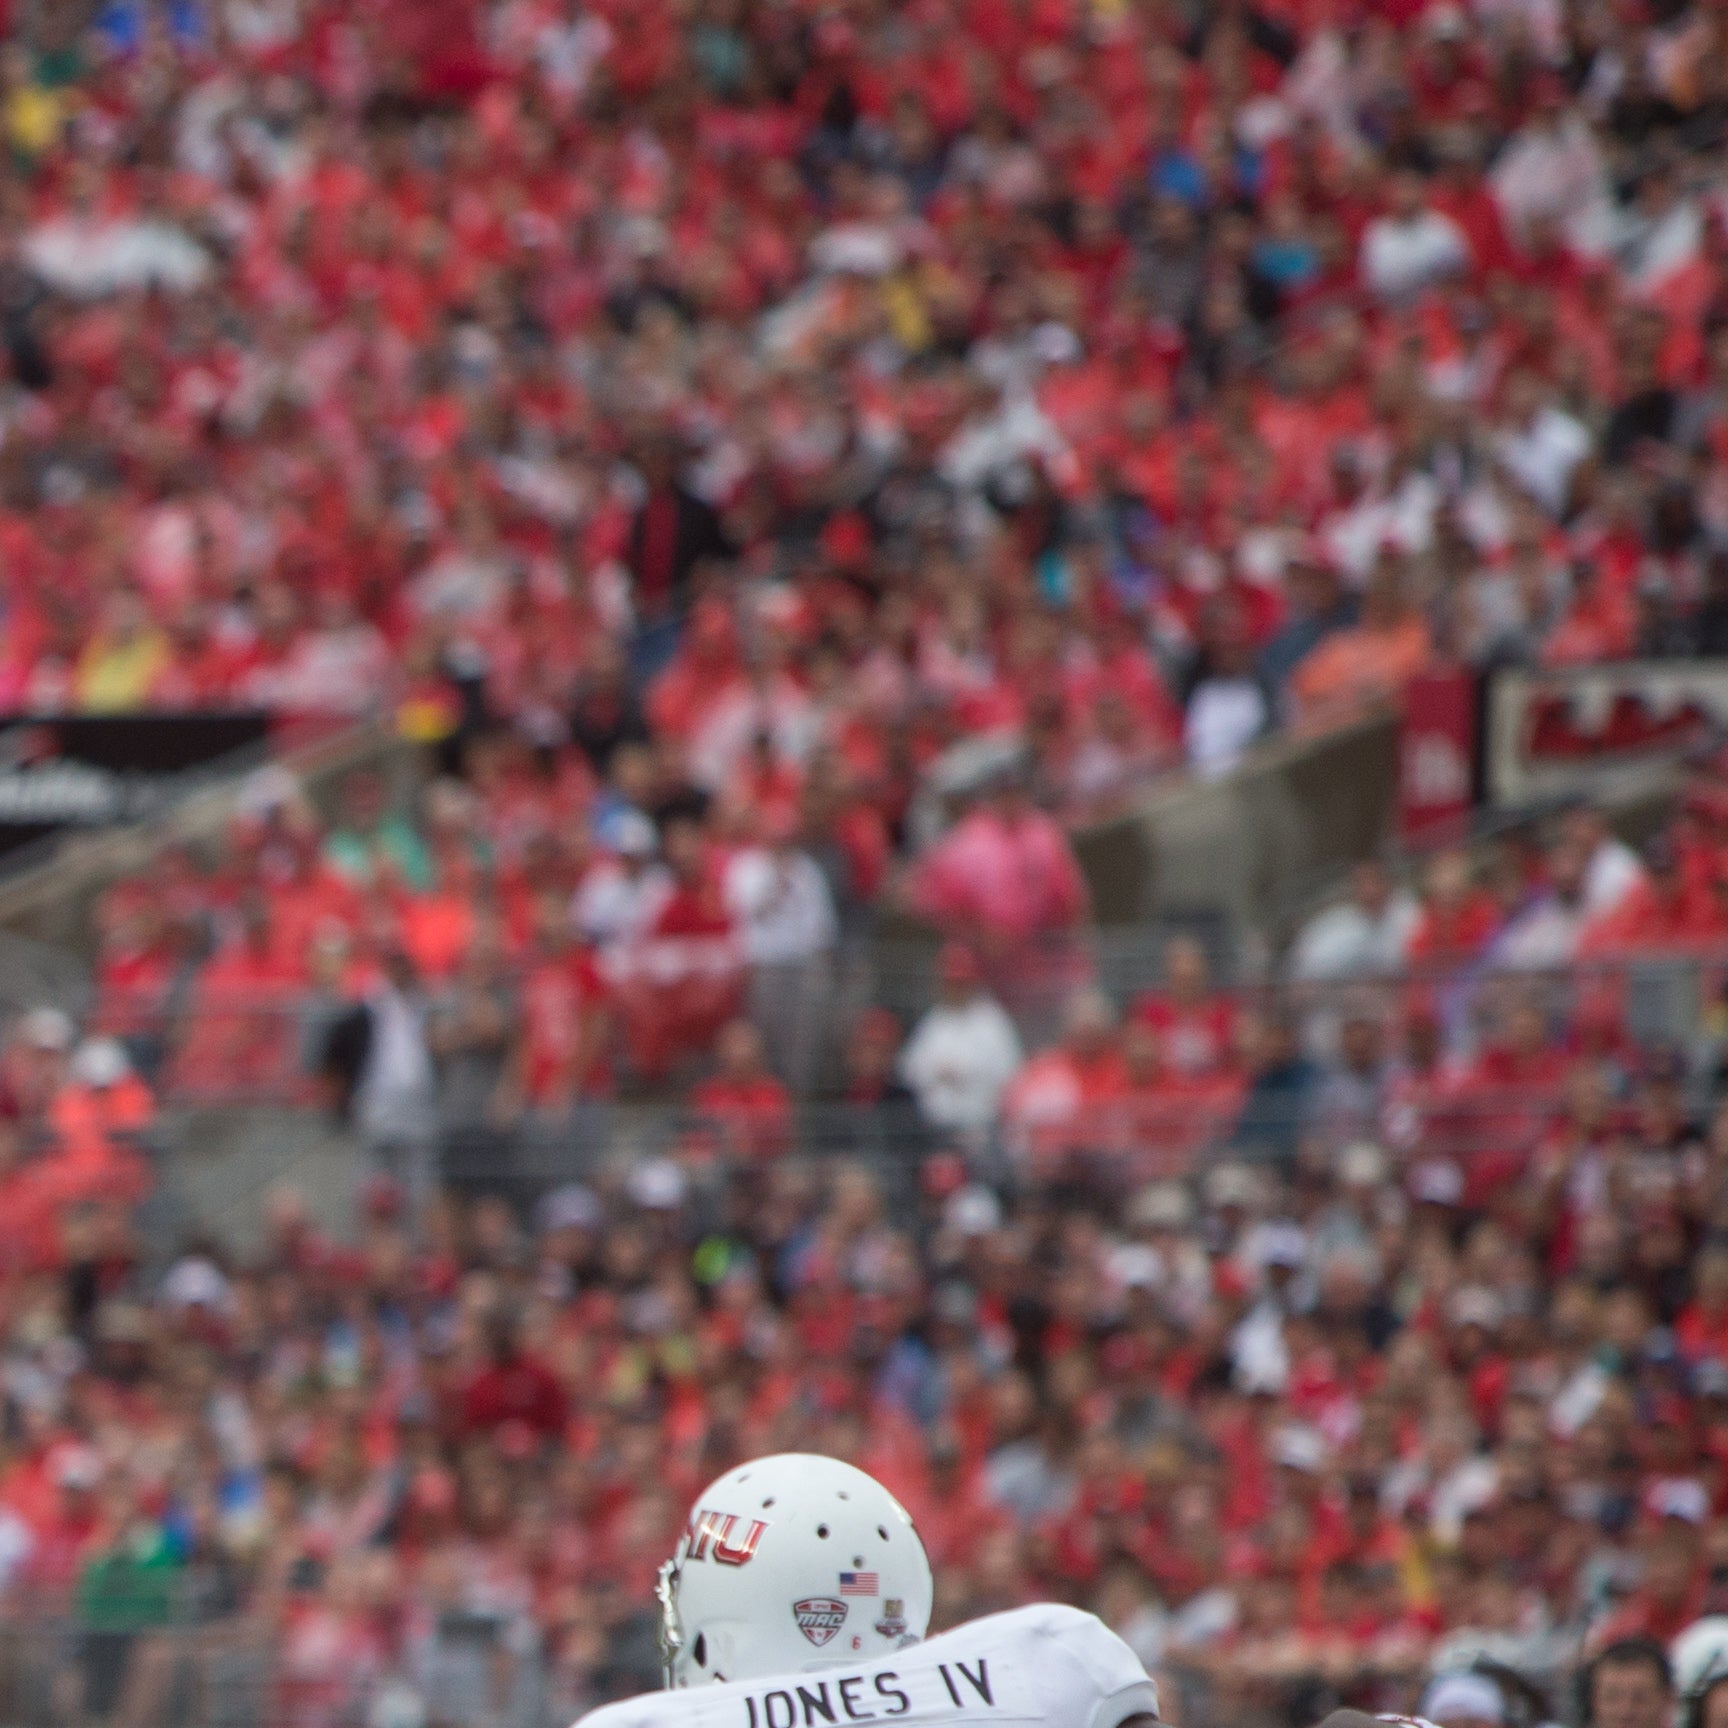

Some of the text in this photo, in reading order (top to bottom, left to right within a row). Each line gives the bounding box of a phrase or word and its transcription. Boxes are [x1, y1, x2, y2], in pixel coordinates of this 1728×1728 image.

[686, 1509, 773, 1567] IU
[798, 1612, 845, 1626] MAC
[937, 1657, 996, 1708] IV
